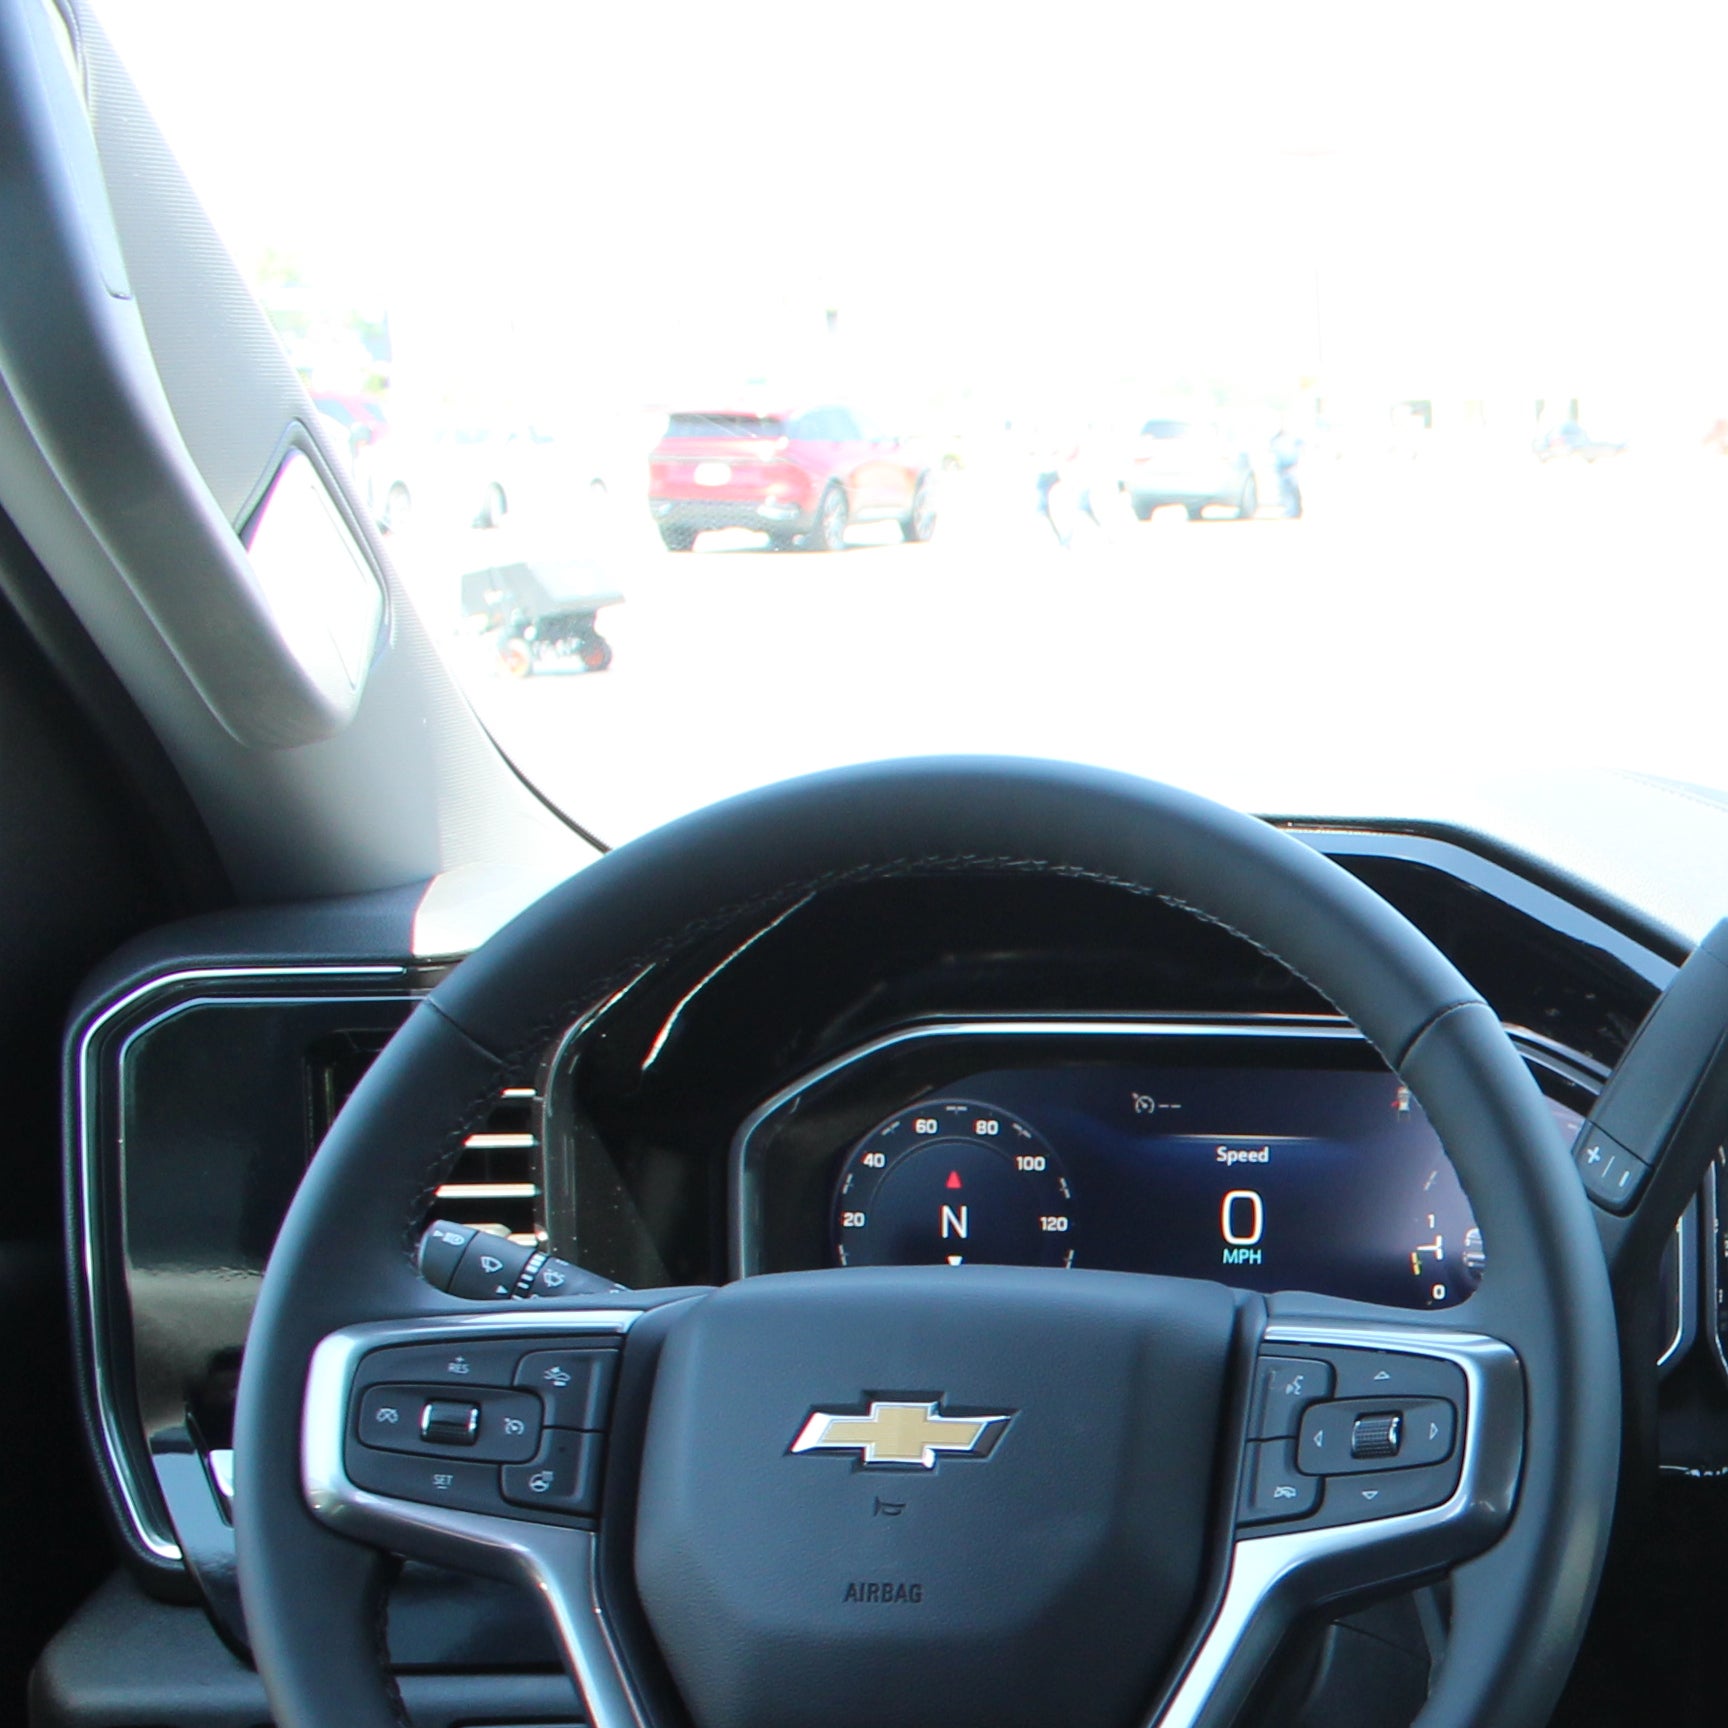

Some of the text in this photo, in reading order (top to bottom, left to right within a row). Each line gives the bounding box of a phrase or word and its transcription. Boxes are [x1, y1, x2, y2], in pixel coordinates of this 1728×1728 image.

[915, 1118, 938, 1136] 60
[974, 1119, 999, 1136] 80
[863, 1152, 886, 1169] 40
[1016, 1155, 1046, 1172] 100
[1216, 1146, 1270, 1167] Speed
[843, 1211, 865, 1228] 20
[941, 1205, 967, 1240] N
[1040, 1215, 1068, 1233] 120
[1221, 1189, 1264, 1245] 0
[1222, 1248, 1263, 1265] MPH
[1432, 1284, 1445, 1300] 0
[434, 1474, 452, 1486] SET
[842, 1582, 924, 1604] AIRBAG
